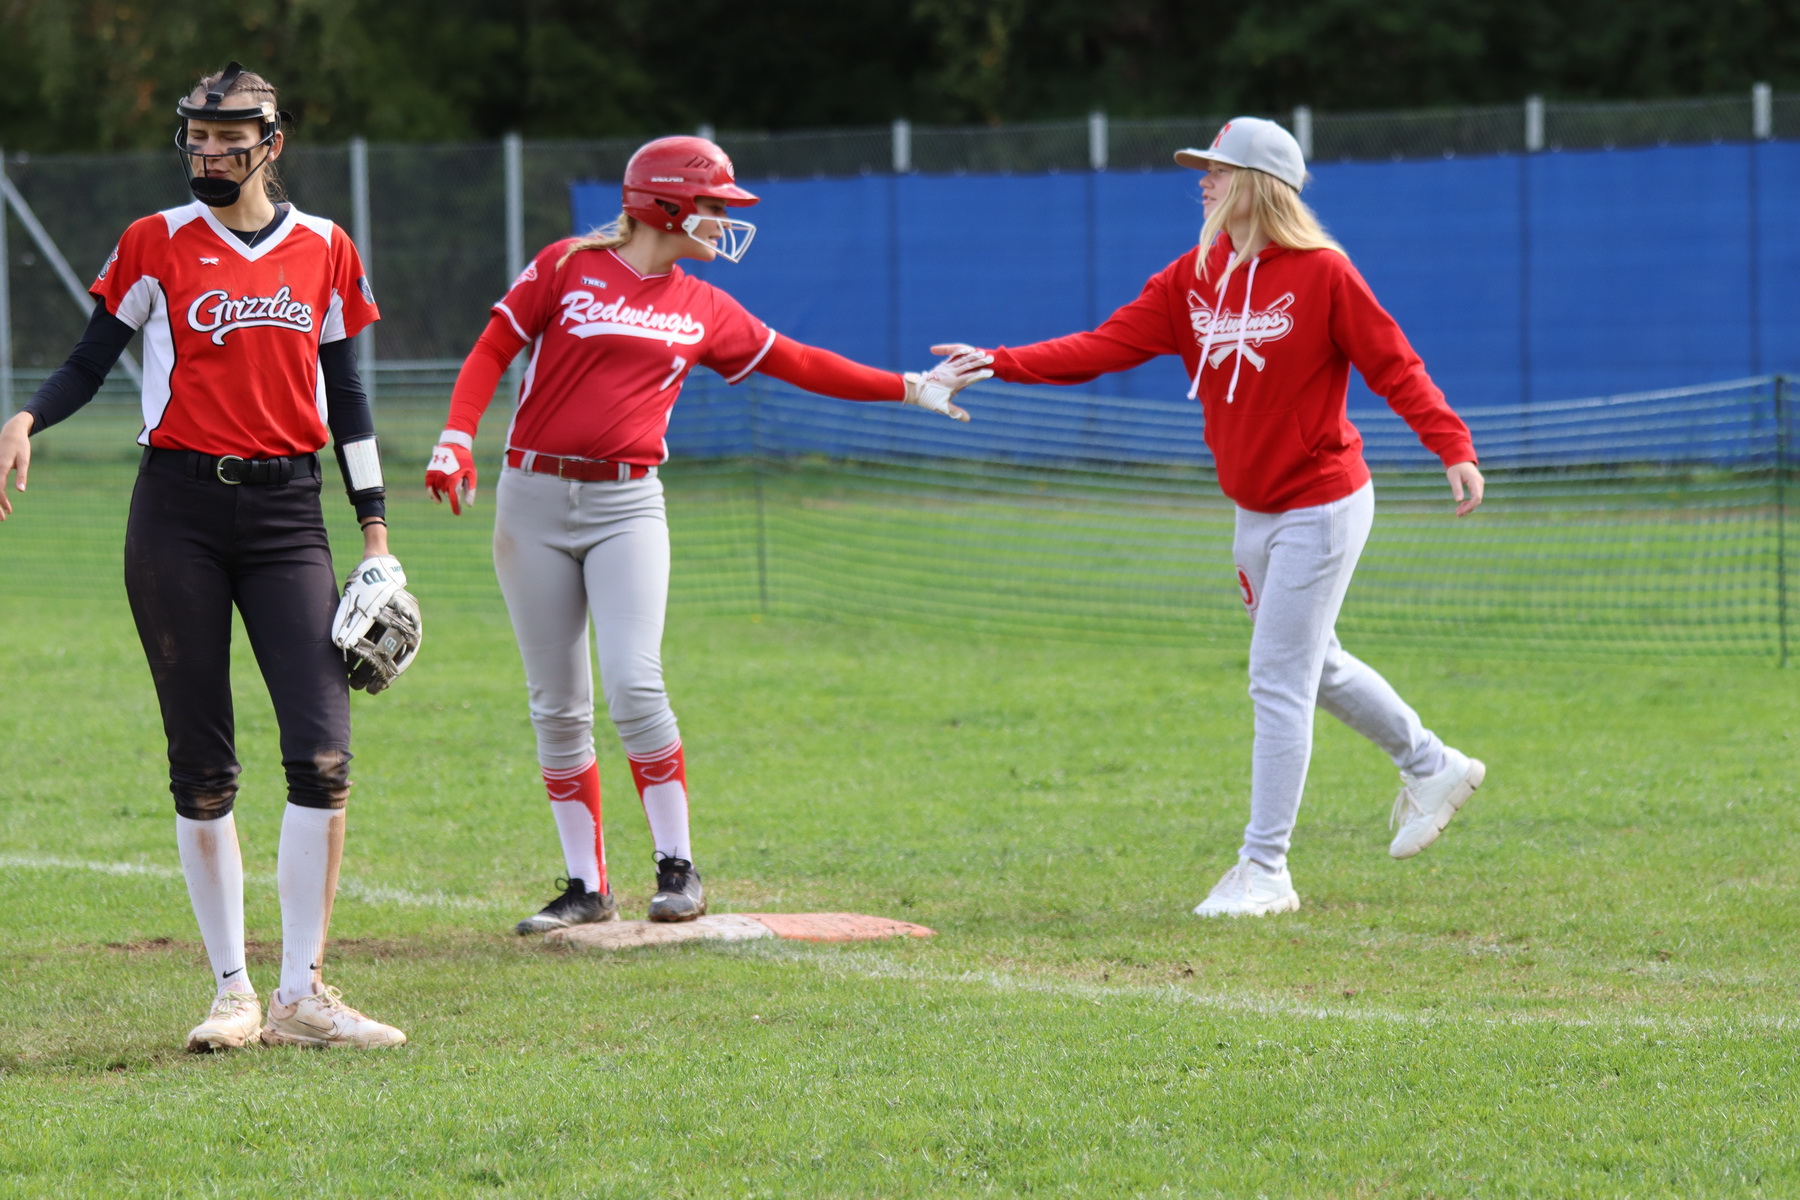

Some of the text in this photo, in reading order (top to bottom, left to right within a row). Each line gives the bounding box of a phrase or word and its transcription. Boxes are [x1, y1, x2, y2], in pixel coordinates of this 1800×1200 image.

[187, 285, 313, 346] Grizzlies
[559, 290, 705, 348] Redwings
[659, 355, 687, 391] 7
